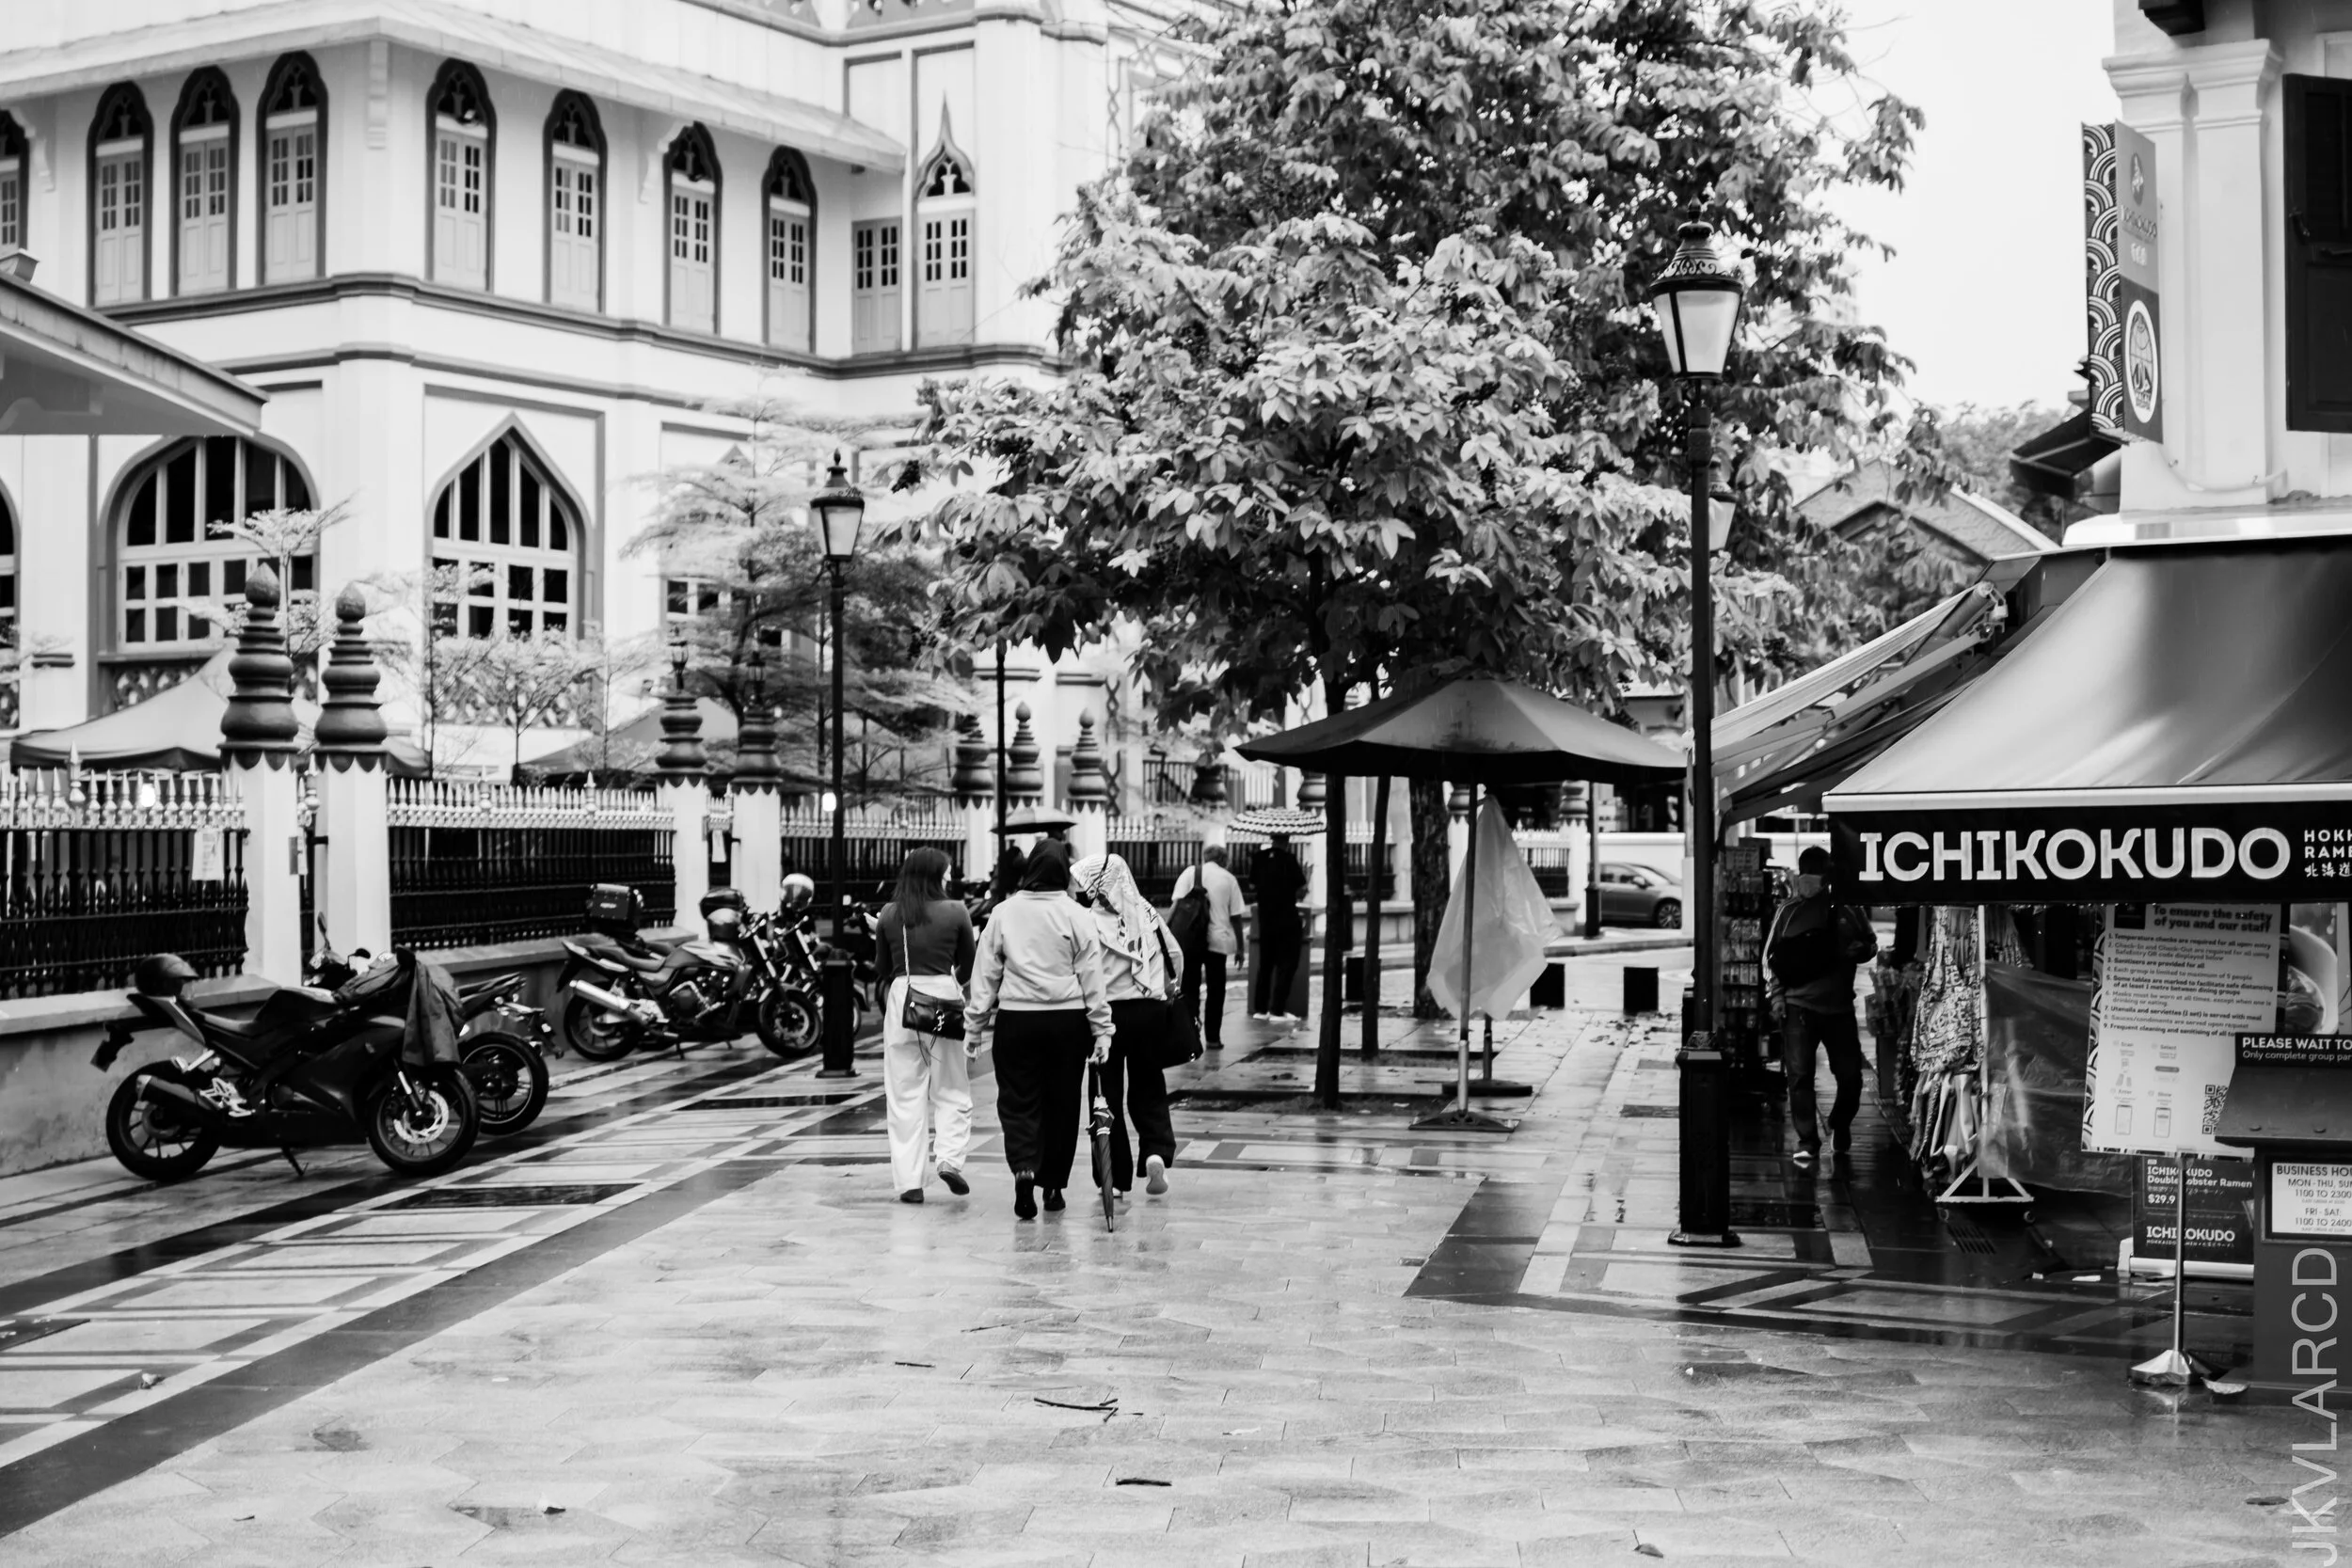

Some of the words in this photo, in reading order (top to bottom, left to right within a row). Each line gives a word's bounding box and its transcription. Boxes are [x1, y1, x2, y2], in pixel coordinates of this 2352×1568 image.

[1859, 827, 2291, 881] ICHIKOKUDO
[2154, 905, 2166, 916] To
[2169, 908, 2210, 918] ensure
[2213, 909, 2232, 920] the
[2235, 911, 2273, 923] safety
[2154, 916, 2168, 926] of
[2169, 920, 2190, 930] you
[2193, 919, 2215, 929] and
[2218, 923, 2238, 931] our
[2241, 922, 2270, 933] staff
[2109, 1022, 2138, 1031] Frequent
[2138, 1025, 2167, 1035] cleaning
[2242, 1037, 2293, 1049] PLEASE
[2295, 1037, 2331, 1050] WAIT
[2334, 1039, 2352, 1051] TO
[2242, 1051, 2264, 1060] Only
[2265, 1051, 2307, 1061] complete
[2309, 1053, 2335, 1062] group
[2277, 1164, 2328, 1177] BUSINESS
[2331, 1166, 2352, 1178] HO
[2185, 1178, 2218, 1186] obster
[2219, 1178, 2252, 1188] Ramen
[2296, 1189, 2314, 1197] 1100
[2316, 1190, 2328, 1198] TO
[2330, 1190, 2352, 1199] 2300
[2296, 1217, 2314, 1226] 1100
[2316, 1218, 2328, 1227] TO
[2330, 1218, 2352, 1227] 2400
[2146, 1226, 2235, 1243] ICHIOKUDO
